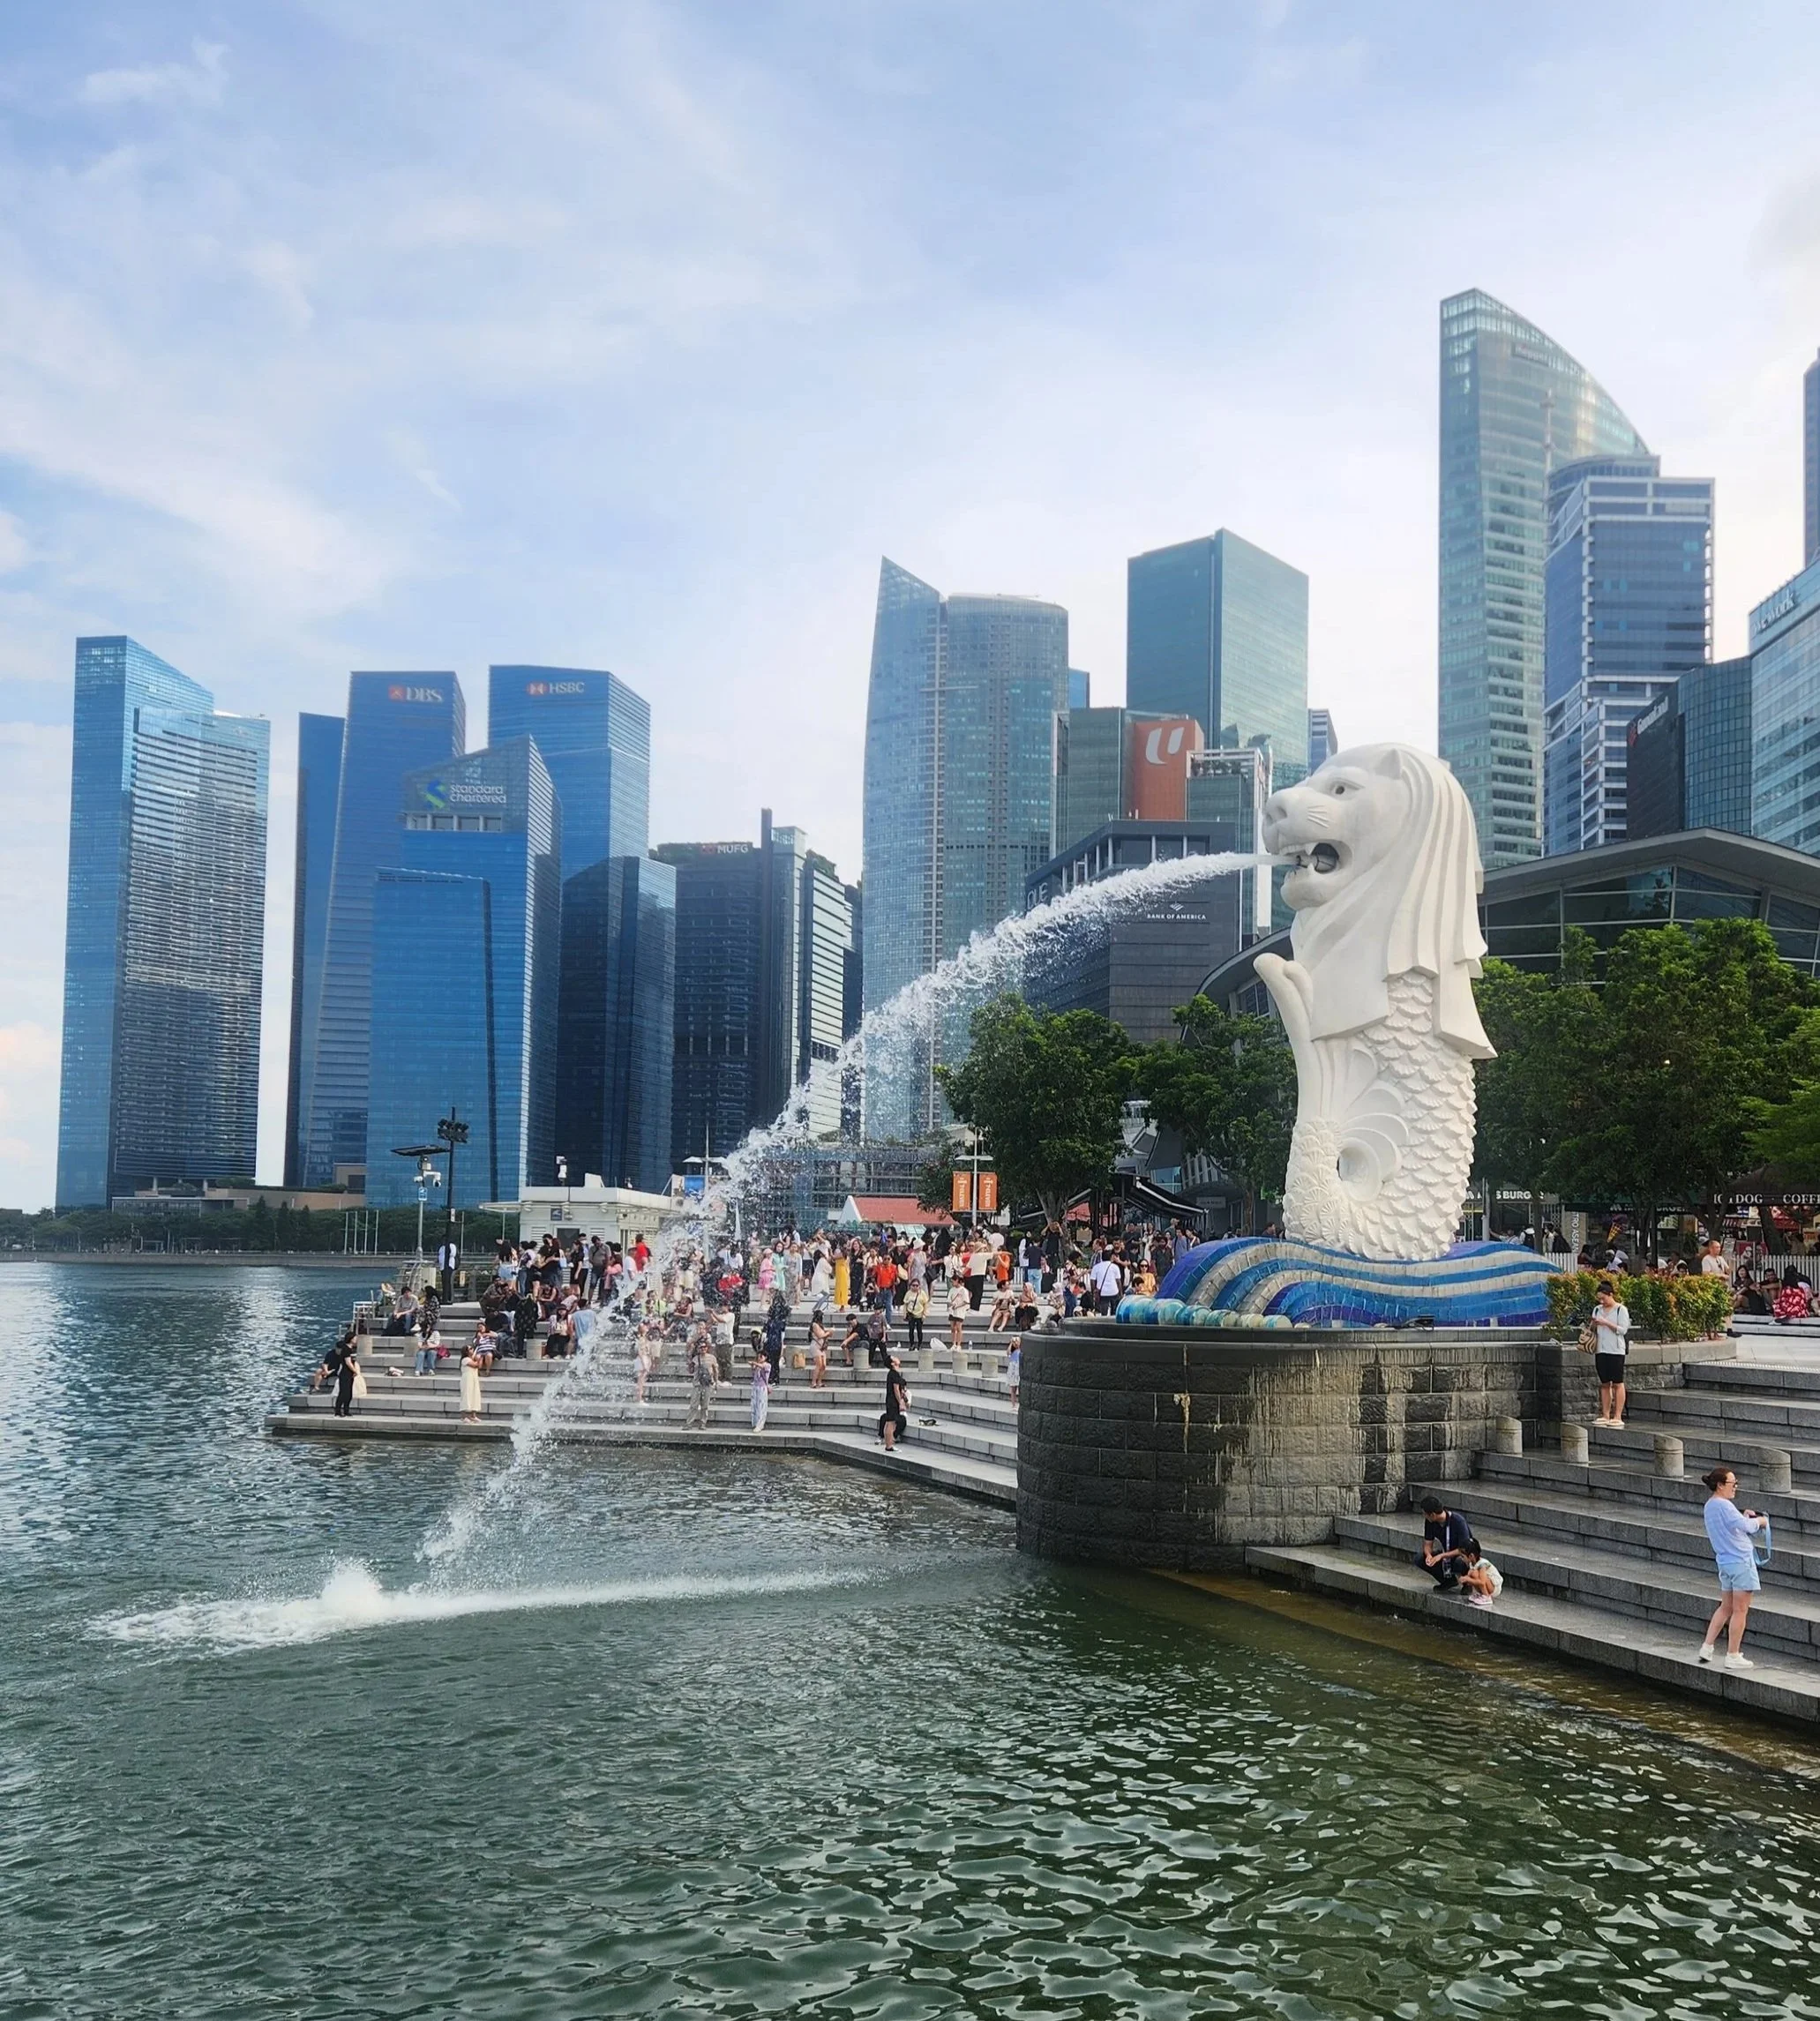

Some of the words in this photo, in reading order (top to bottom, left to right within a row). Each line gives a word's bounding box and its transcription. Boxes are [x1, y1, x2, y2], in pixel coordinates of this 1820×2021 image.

[549, 682, 585, 694] HSBC
[406, 686, 443, 702] DBS
[450, 793, 507, 804] chartered
[717, 844, 748, 854] MUFG
[1735, 1194, 1764, 1204] DOG
